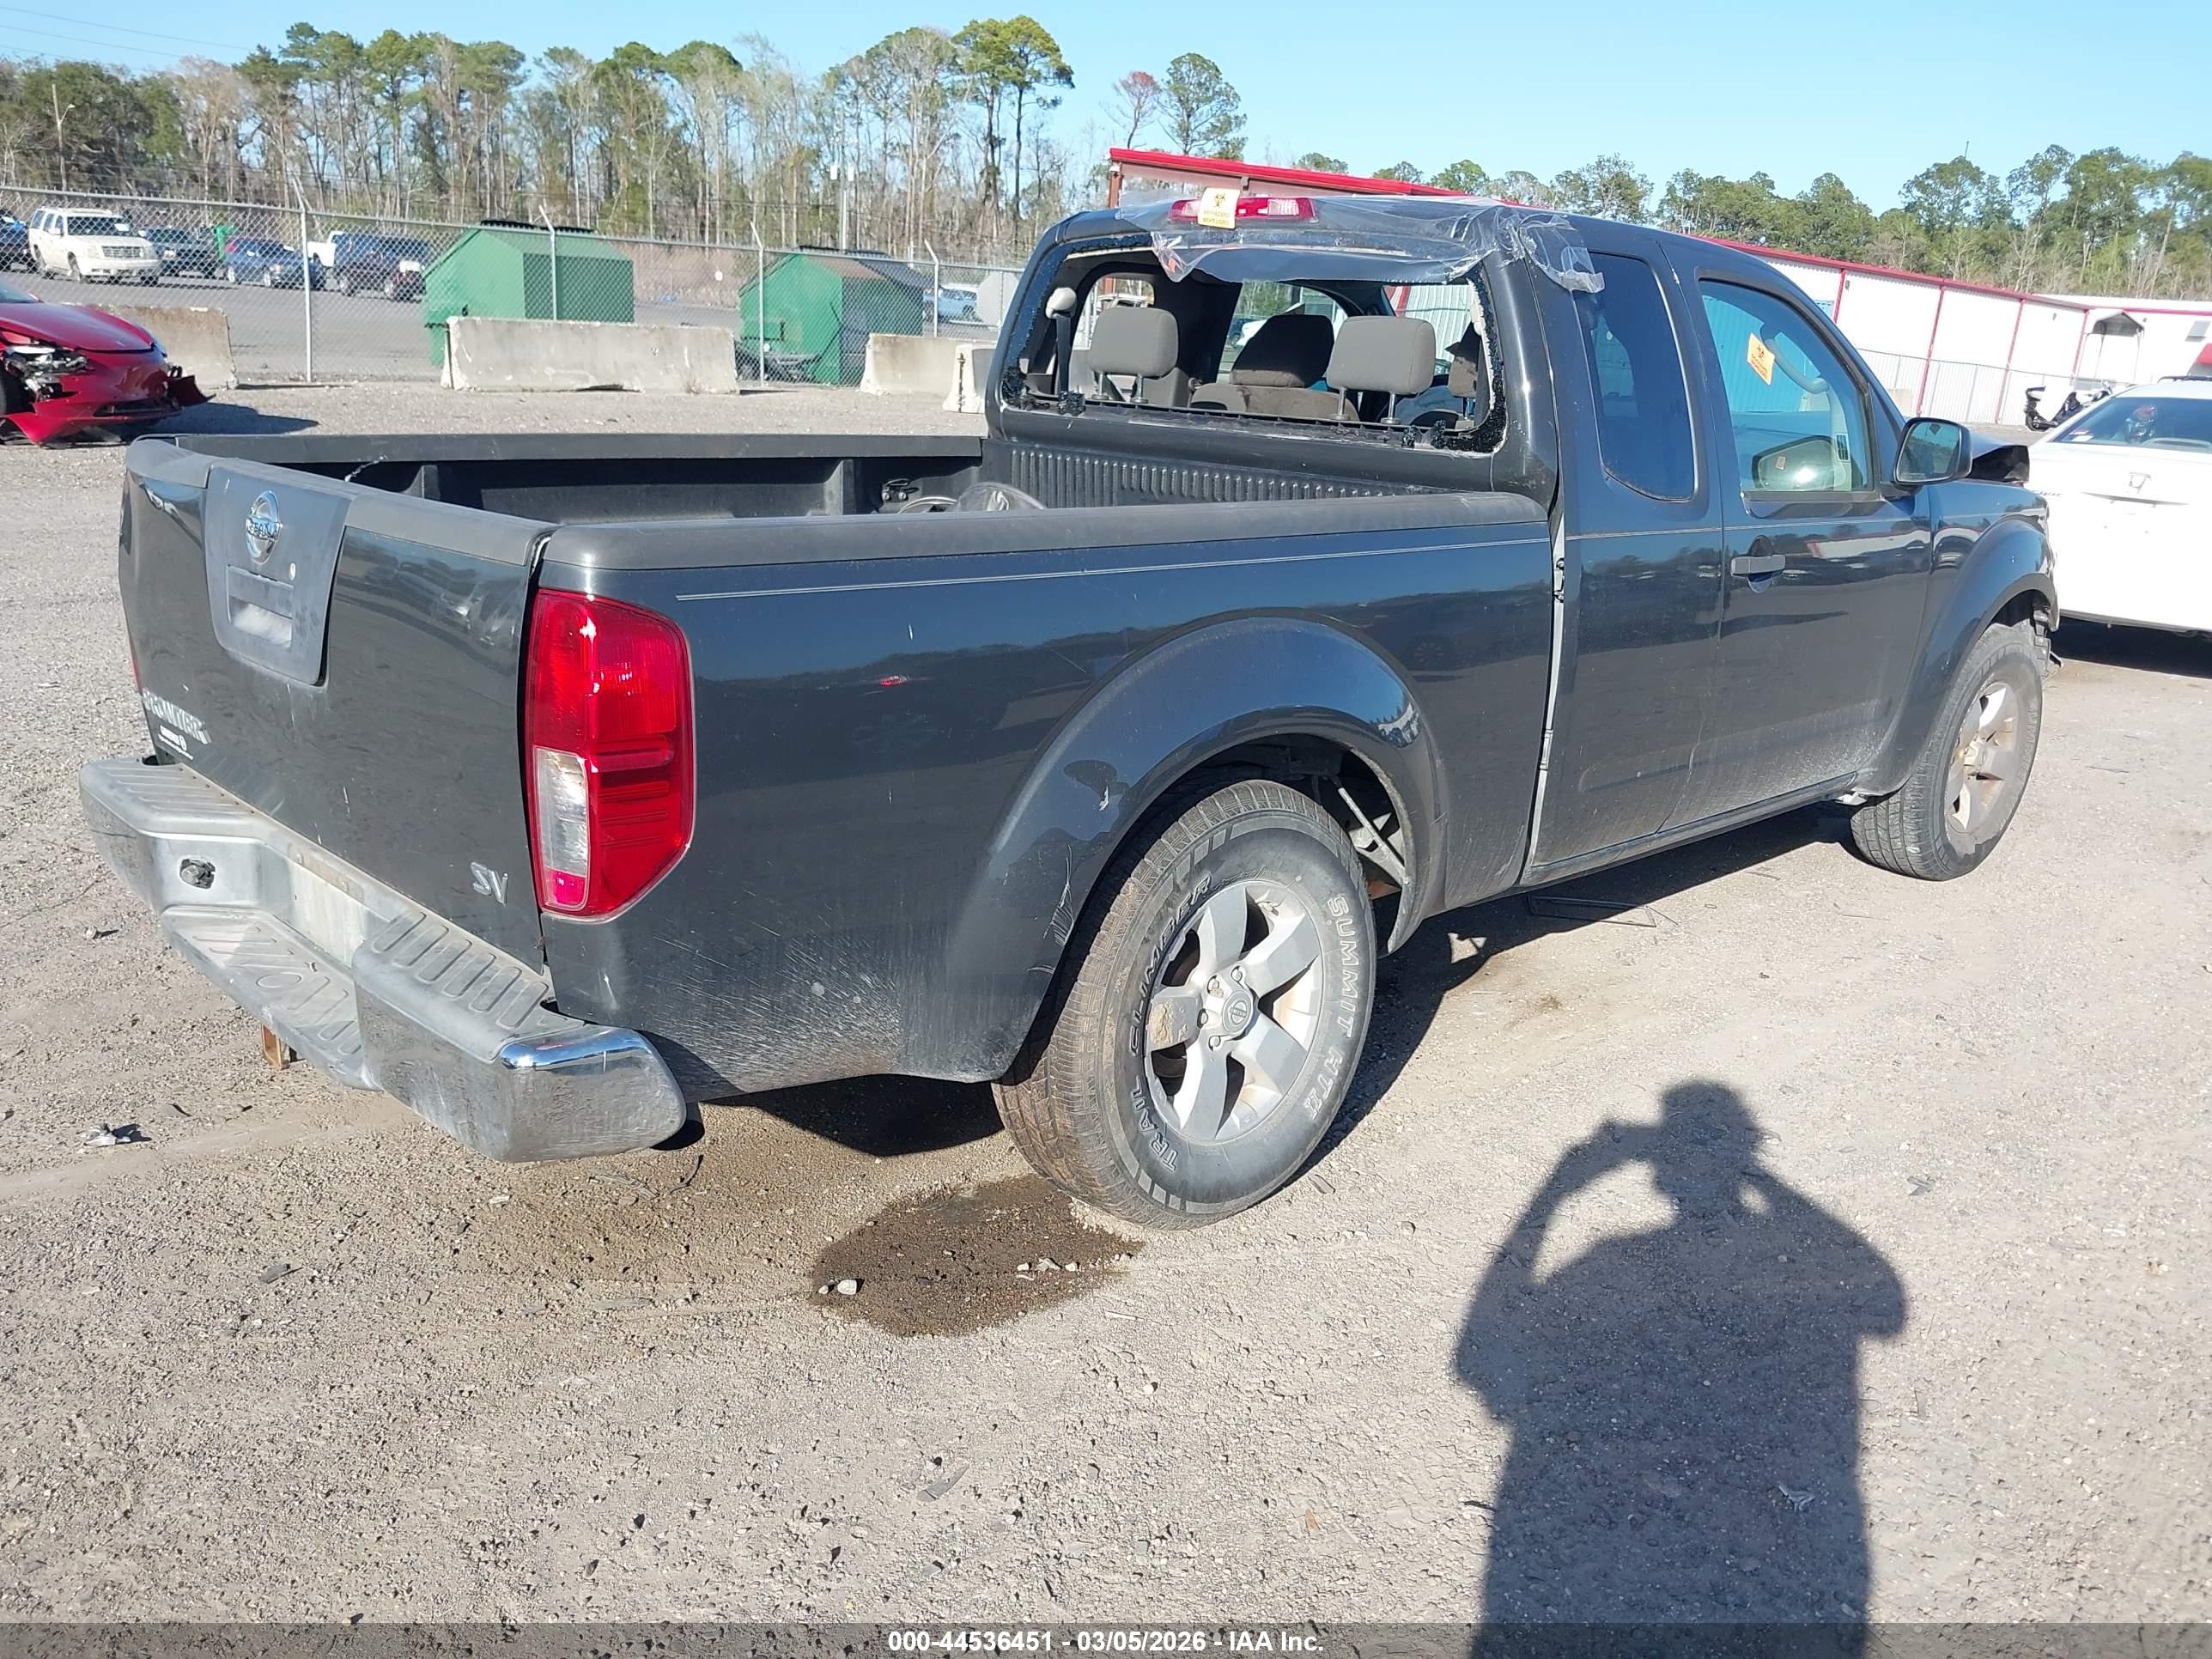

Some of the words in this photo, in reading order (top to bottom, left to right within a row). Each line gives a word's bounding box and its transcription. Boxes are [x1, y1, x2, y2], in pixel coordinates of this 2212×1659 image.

[470, 861, 508, 906] SV
[1128, 874, 1212, 1057] CLIMBER
[1328, 895, 1360, 1037] SUMMIT
[1132, 1074, 1177, 1172] TRAIL
